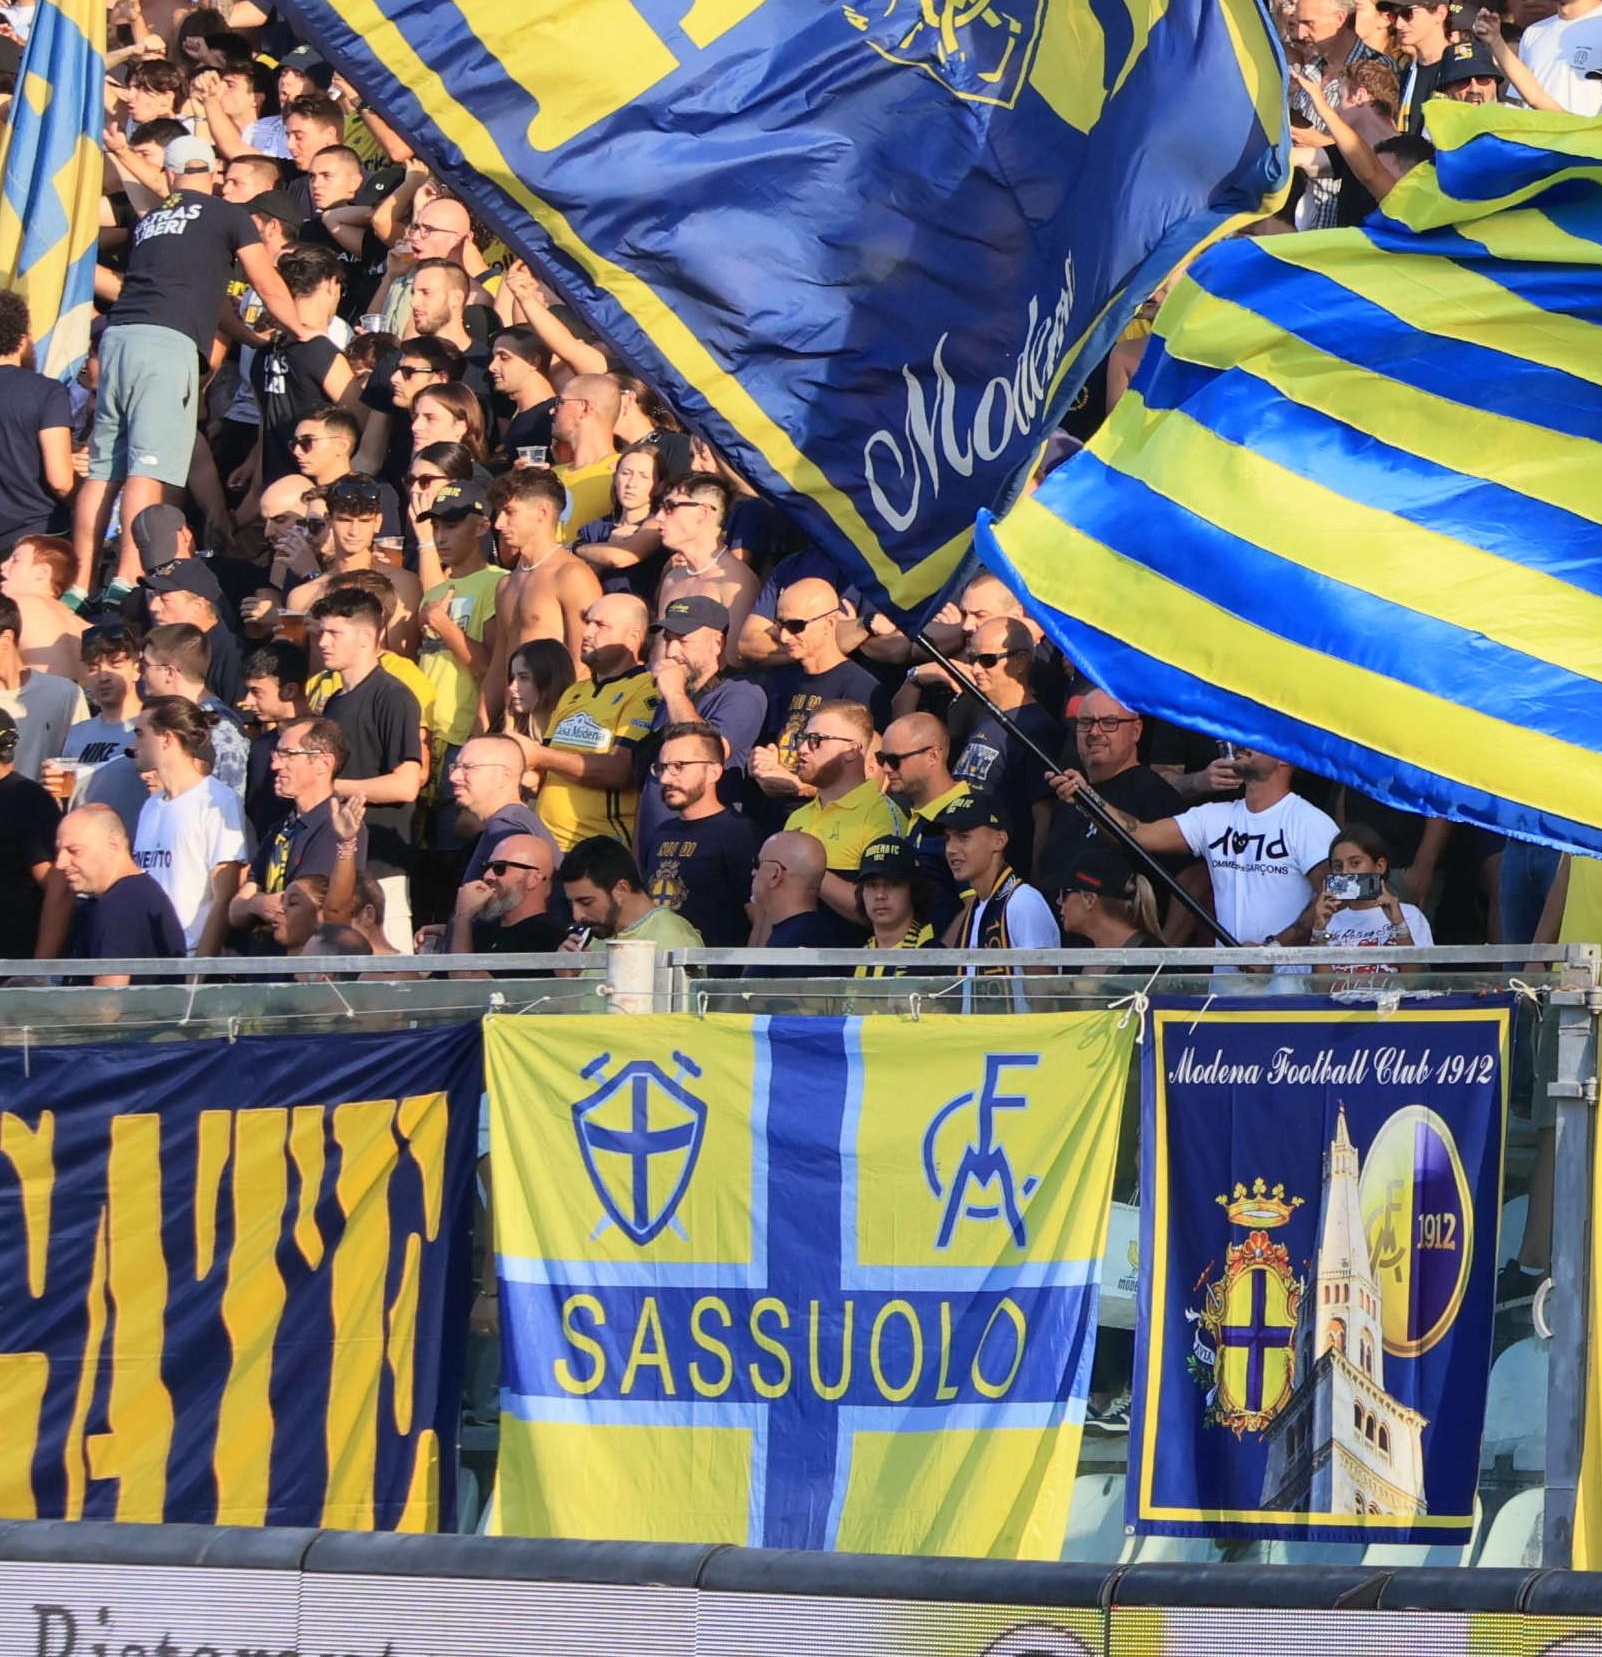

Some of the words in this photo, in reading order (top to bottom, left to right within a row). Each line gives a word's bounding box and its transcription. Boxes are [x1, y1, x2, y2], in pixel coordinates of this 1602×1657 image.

[1168, 1046, 1264, 1085] Modena
[1267, 1046, 1370, 1085] Football
[1373, 1045, 1433, 1085] Club
[1435, 1053, 1495, 1085] 1912
[1417, 1212, 1458, 1251] 1912
[552, 1292, 1027, 1402] SASSUOLO
